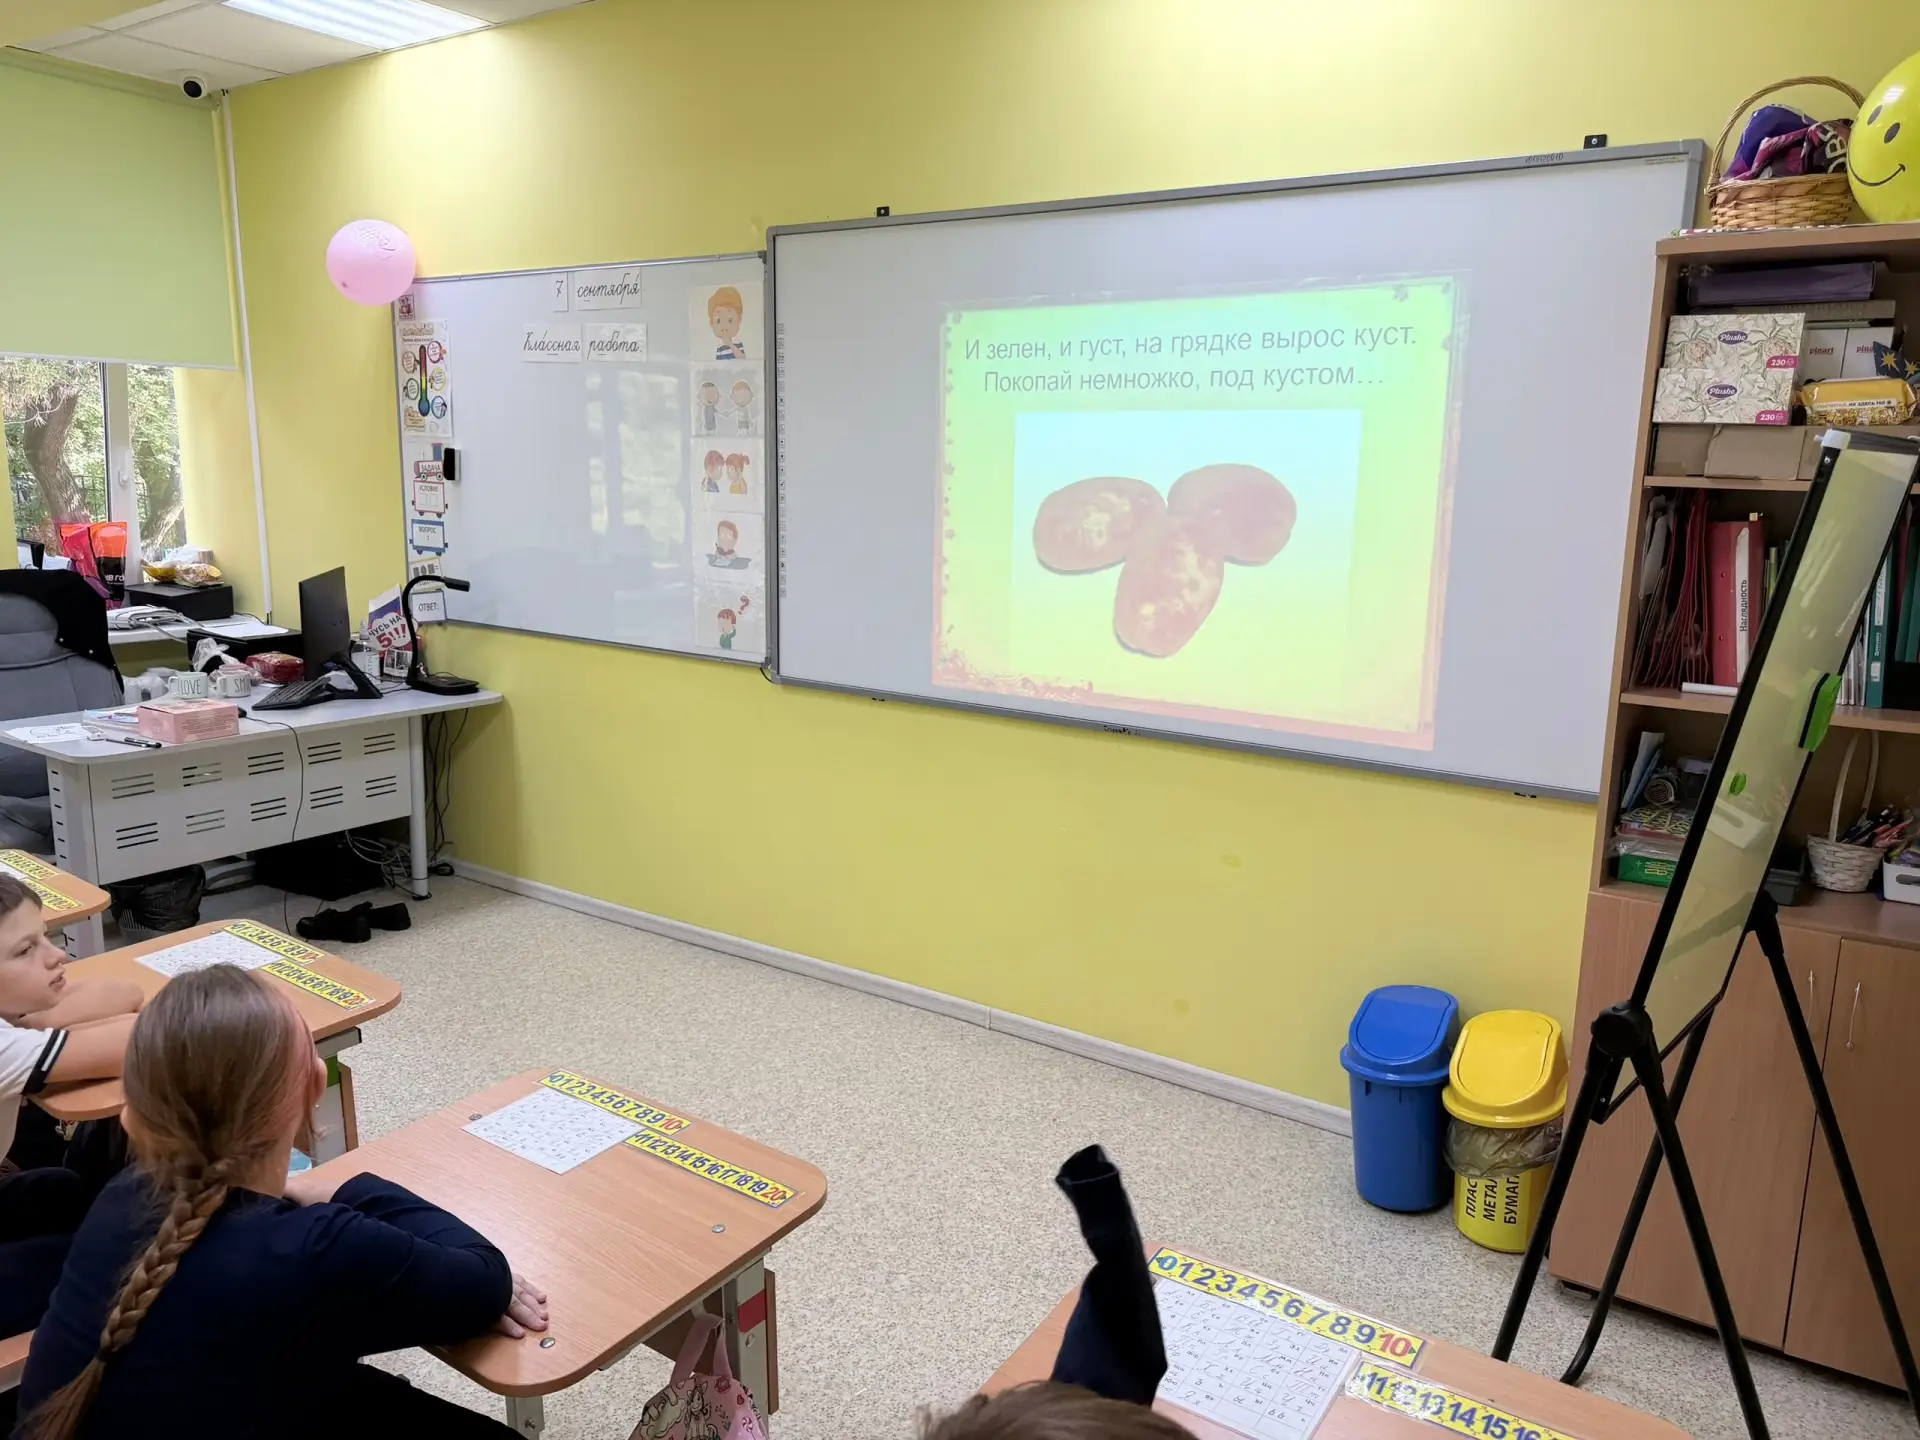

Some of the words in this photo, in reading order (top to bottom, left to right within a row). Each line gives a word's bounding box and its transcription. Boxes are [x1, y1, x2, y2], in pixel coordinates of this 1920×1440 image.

[555, 280, 564, 298] 7
[965, 339, 980, 360] И
[986, 341, 1051, 361] зелен,
[1060, 340, 1072, 357] и
[1080, 337, 1126, 362] густ,
[1135, 335, 1162, 354] на
[1171, 332, 1252, 358] грядке
[1261, 328, 1345, 354] вырос
[1355, 326, 1416, 352] куст.
[984, 370, 1072, 392] Покопай
[1080, 370, 1200, 391] немножко,
[1210, 368, 1255, 391] под
[1739, 579, 1748, 632] Наглядность
[389, 614, 402, 626] НА
[180, 679, 202, 695] LOVE
